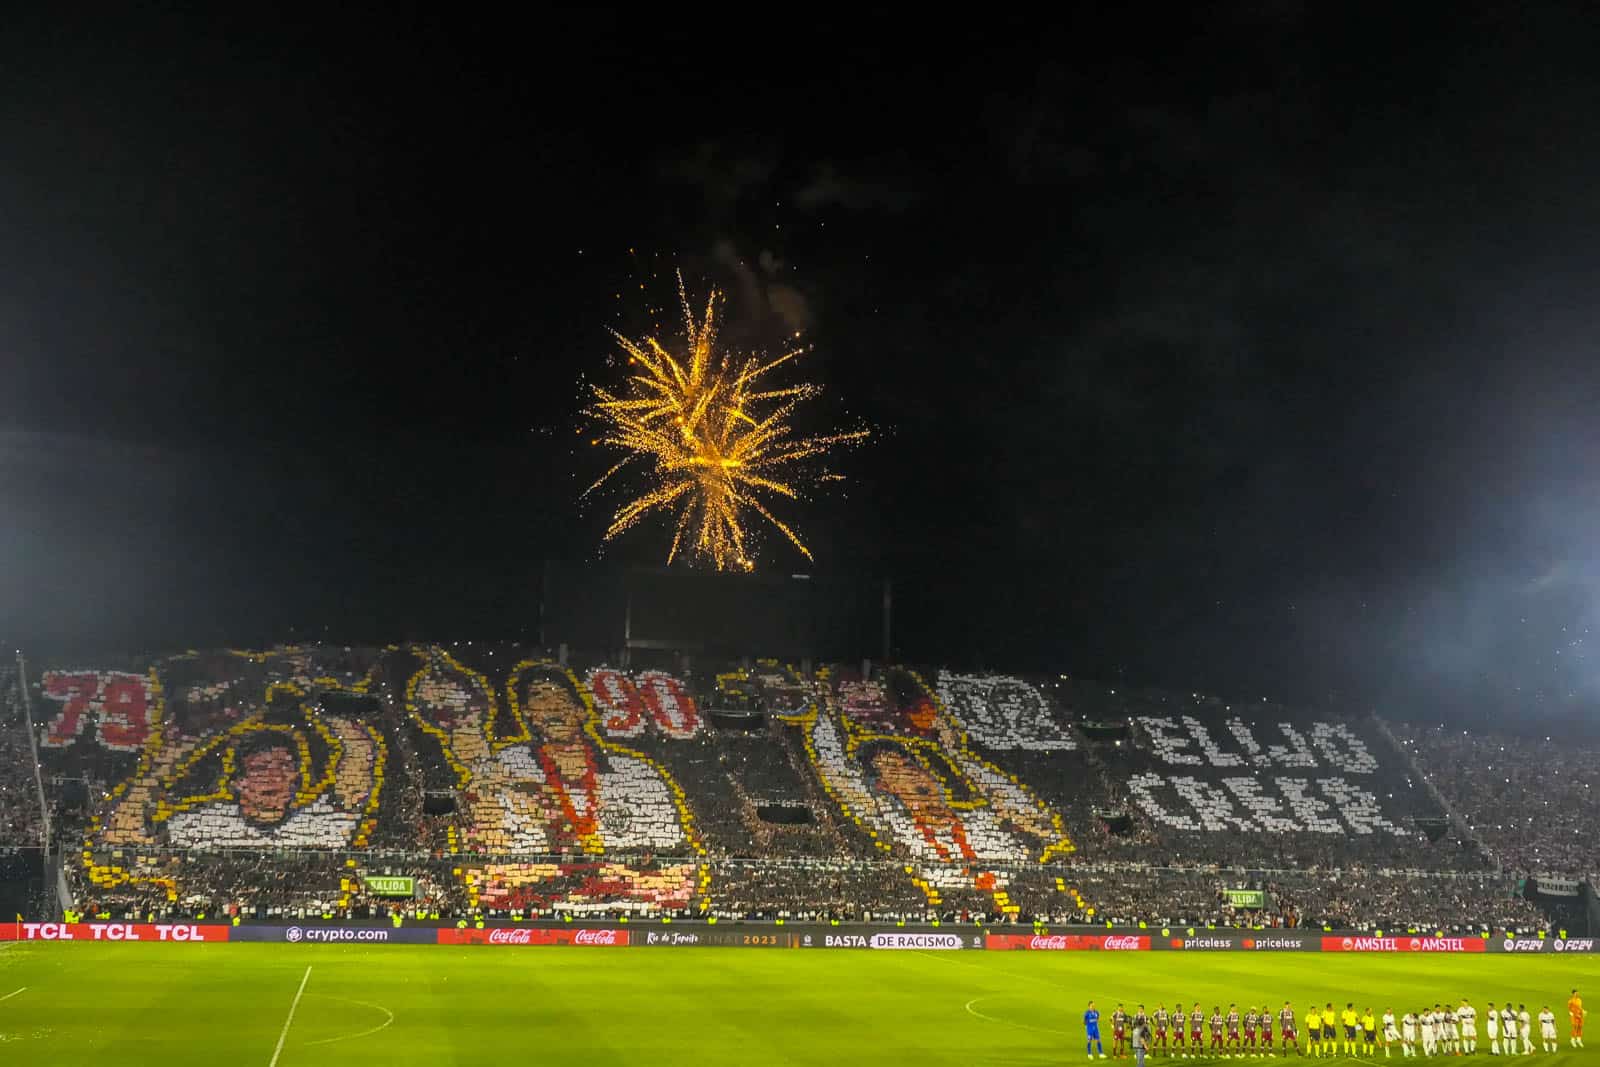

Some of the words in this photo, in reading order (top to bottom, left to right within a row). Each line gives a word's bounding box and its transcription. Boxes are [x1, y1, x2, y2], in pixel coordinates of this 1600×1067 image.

[583, 664, 704, 740] 90
[40, 670, 152, 752] 79
[1127, 772, 1412, 836] CREER
[1230, 893, 1257, 904] ALIDA
[23, 923, 73, 939] TCL
[90, 924, 139, 940] TCL
[155, 924, 204, 941] TCL
[306, 928, 388, 941] crypto.com
[743, 935, 777, 945] 2023
[825, 935, 867, 947] BASTA
[877, 936, 895, 947] DE
[899, 936, 956, 948] RACISMO
[1184, 937, 1232, 949] priceless
[1256, 938, 1302, 949] priceless
[1354, 938, 1398, 950] AMSTEL
[1422, 938, 1465, 951] AMSTEL
